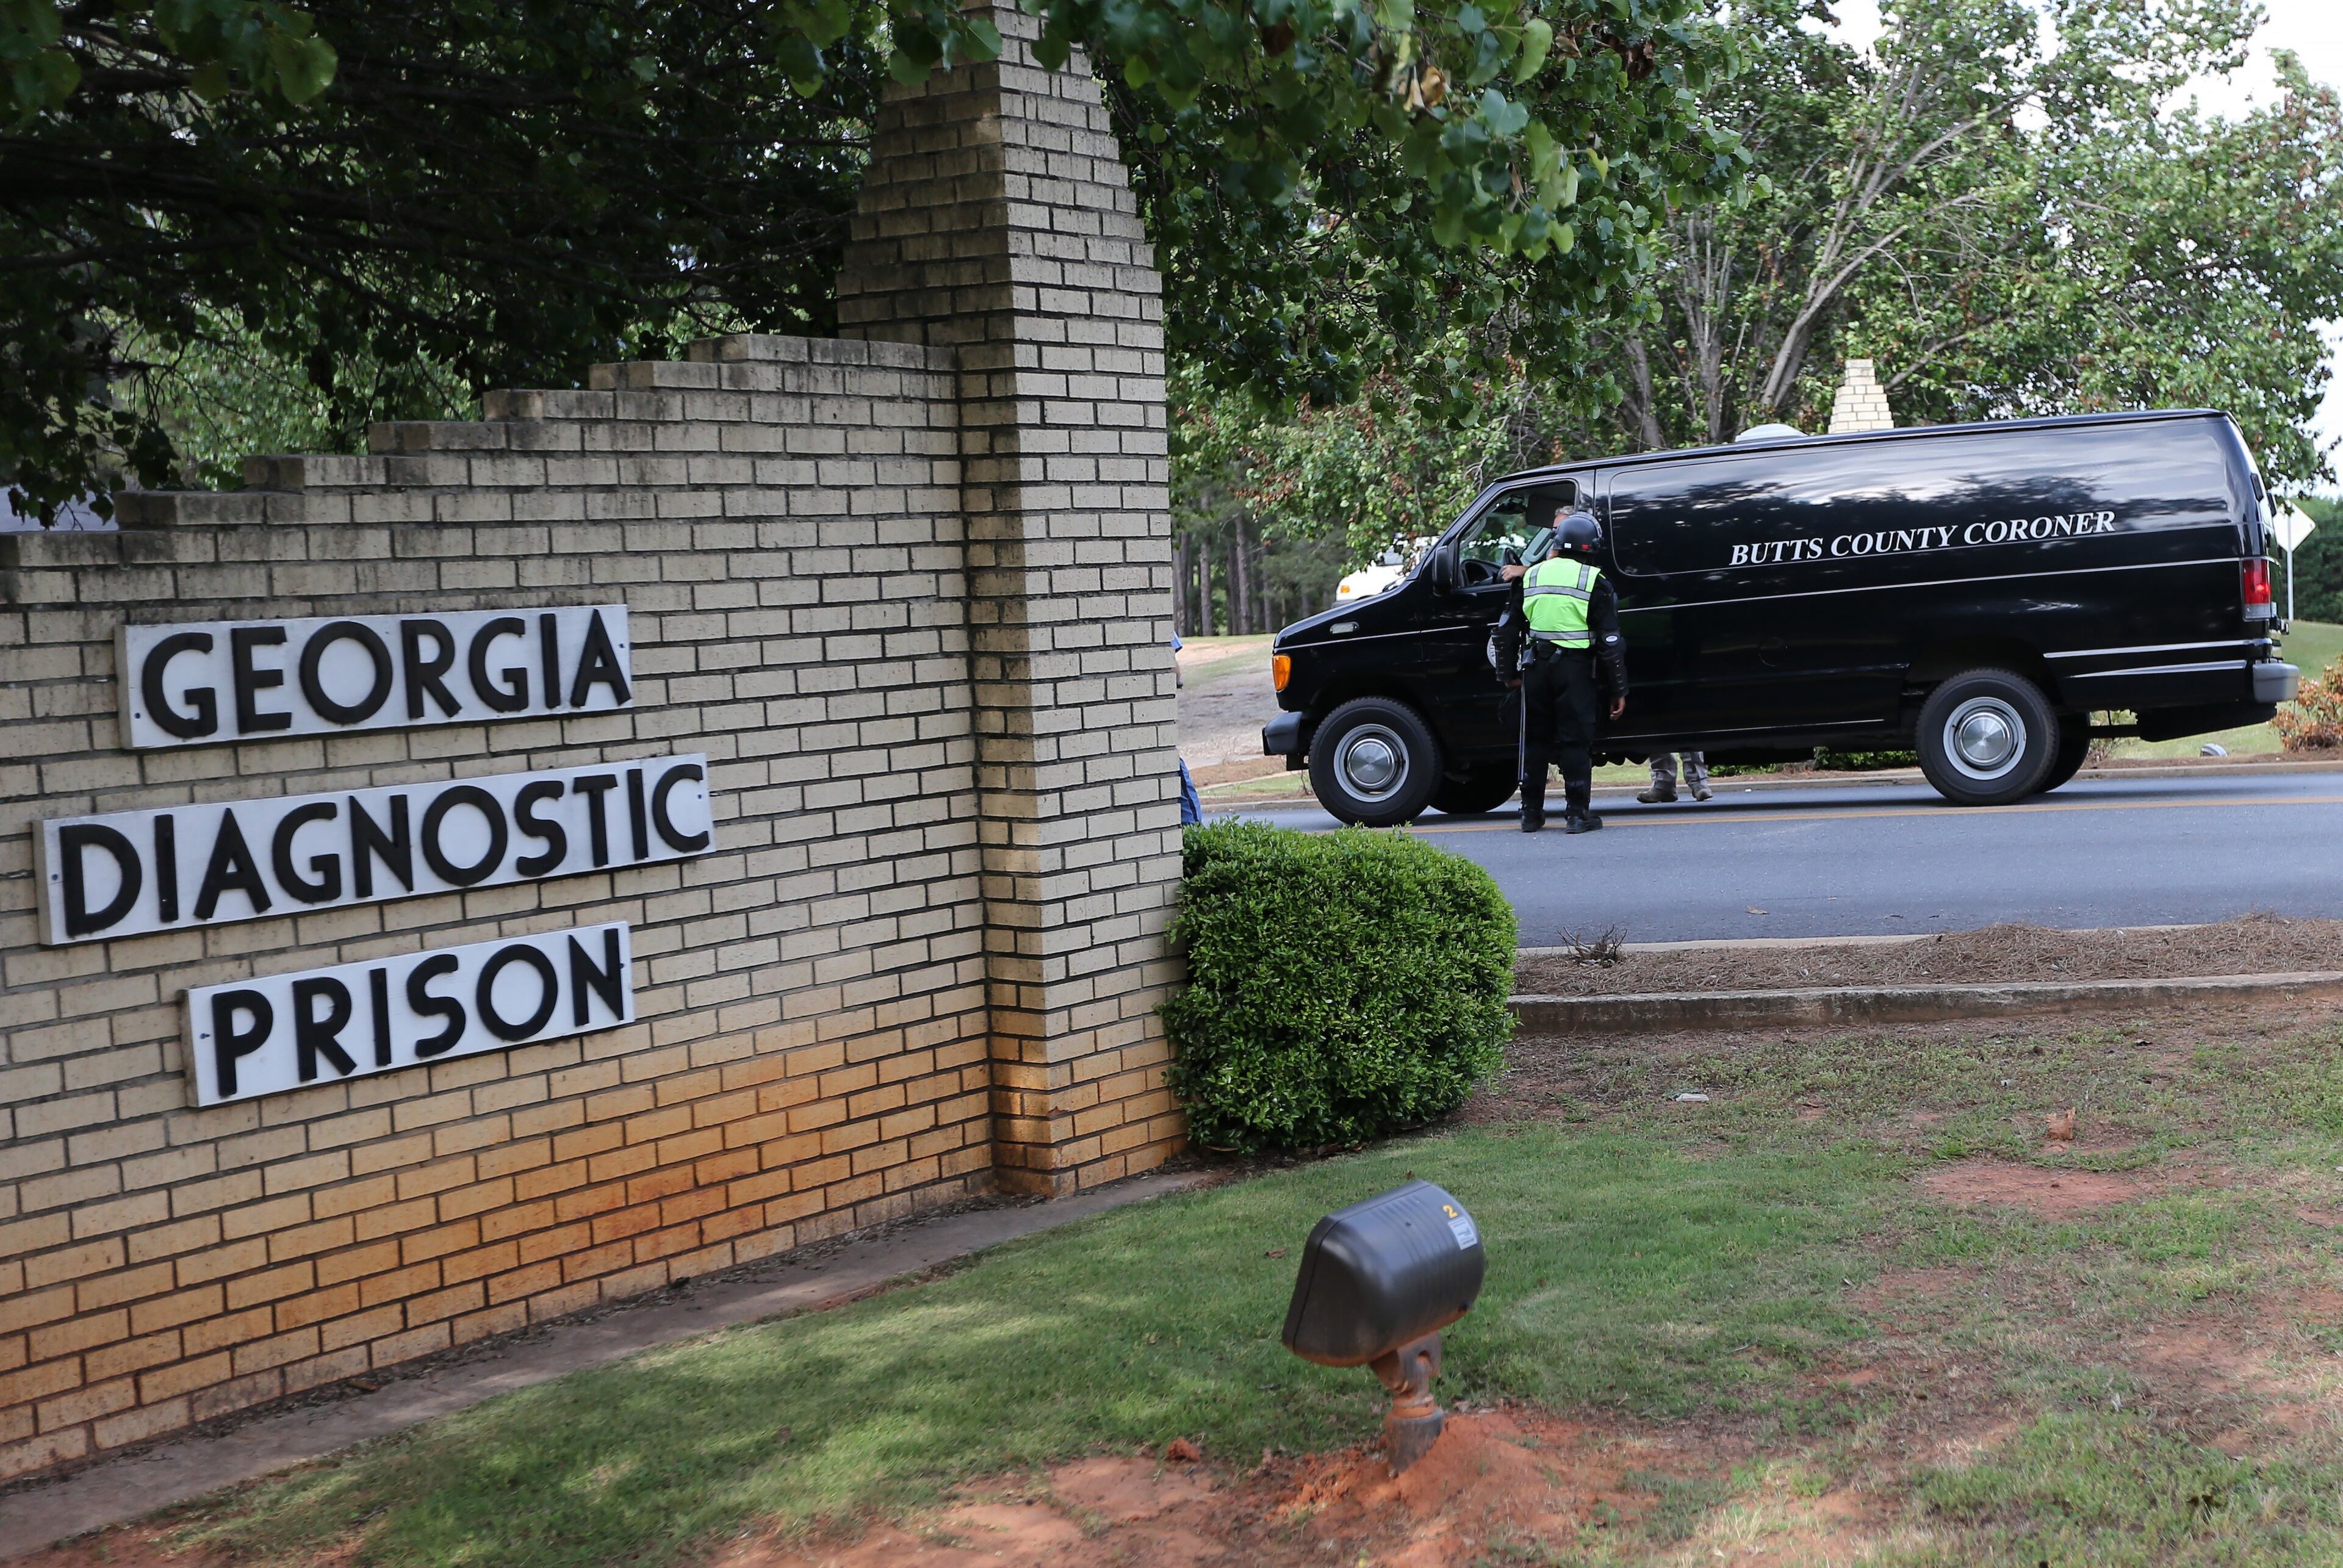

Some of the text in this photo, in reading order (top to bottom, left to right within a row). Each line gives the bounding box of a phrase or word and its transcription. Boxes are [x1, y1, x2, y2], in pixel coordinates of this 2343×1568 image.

[1729, 510, 2116, 566] BUTTS COUNTY CORONER
[141, 608, 632, 738] GEORGIA
[60, 764, 710, 938] DIAGNOSTIC
[212, 929, 624, 1097] PRISON
[1442, 1204, 1458, 1218] 2
